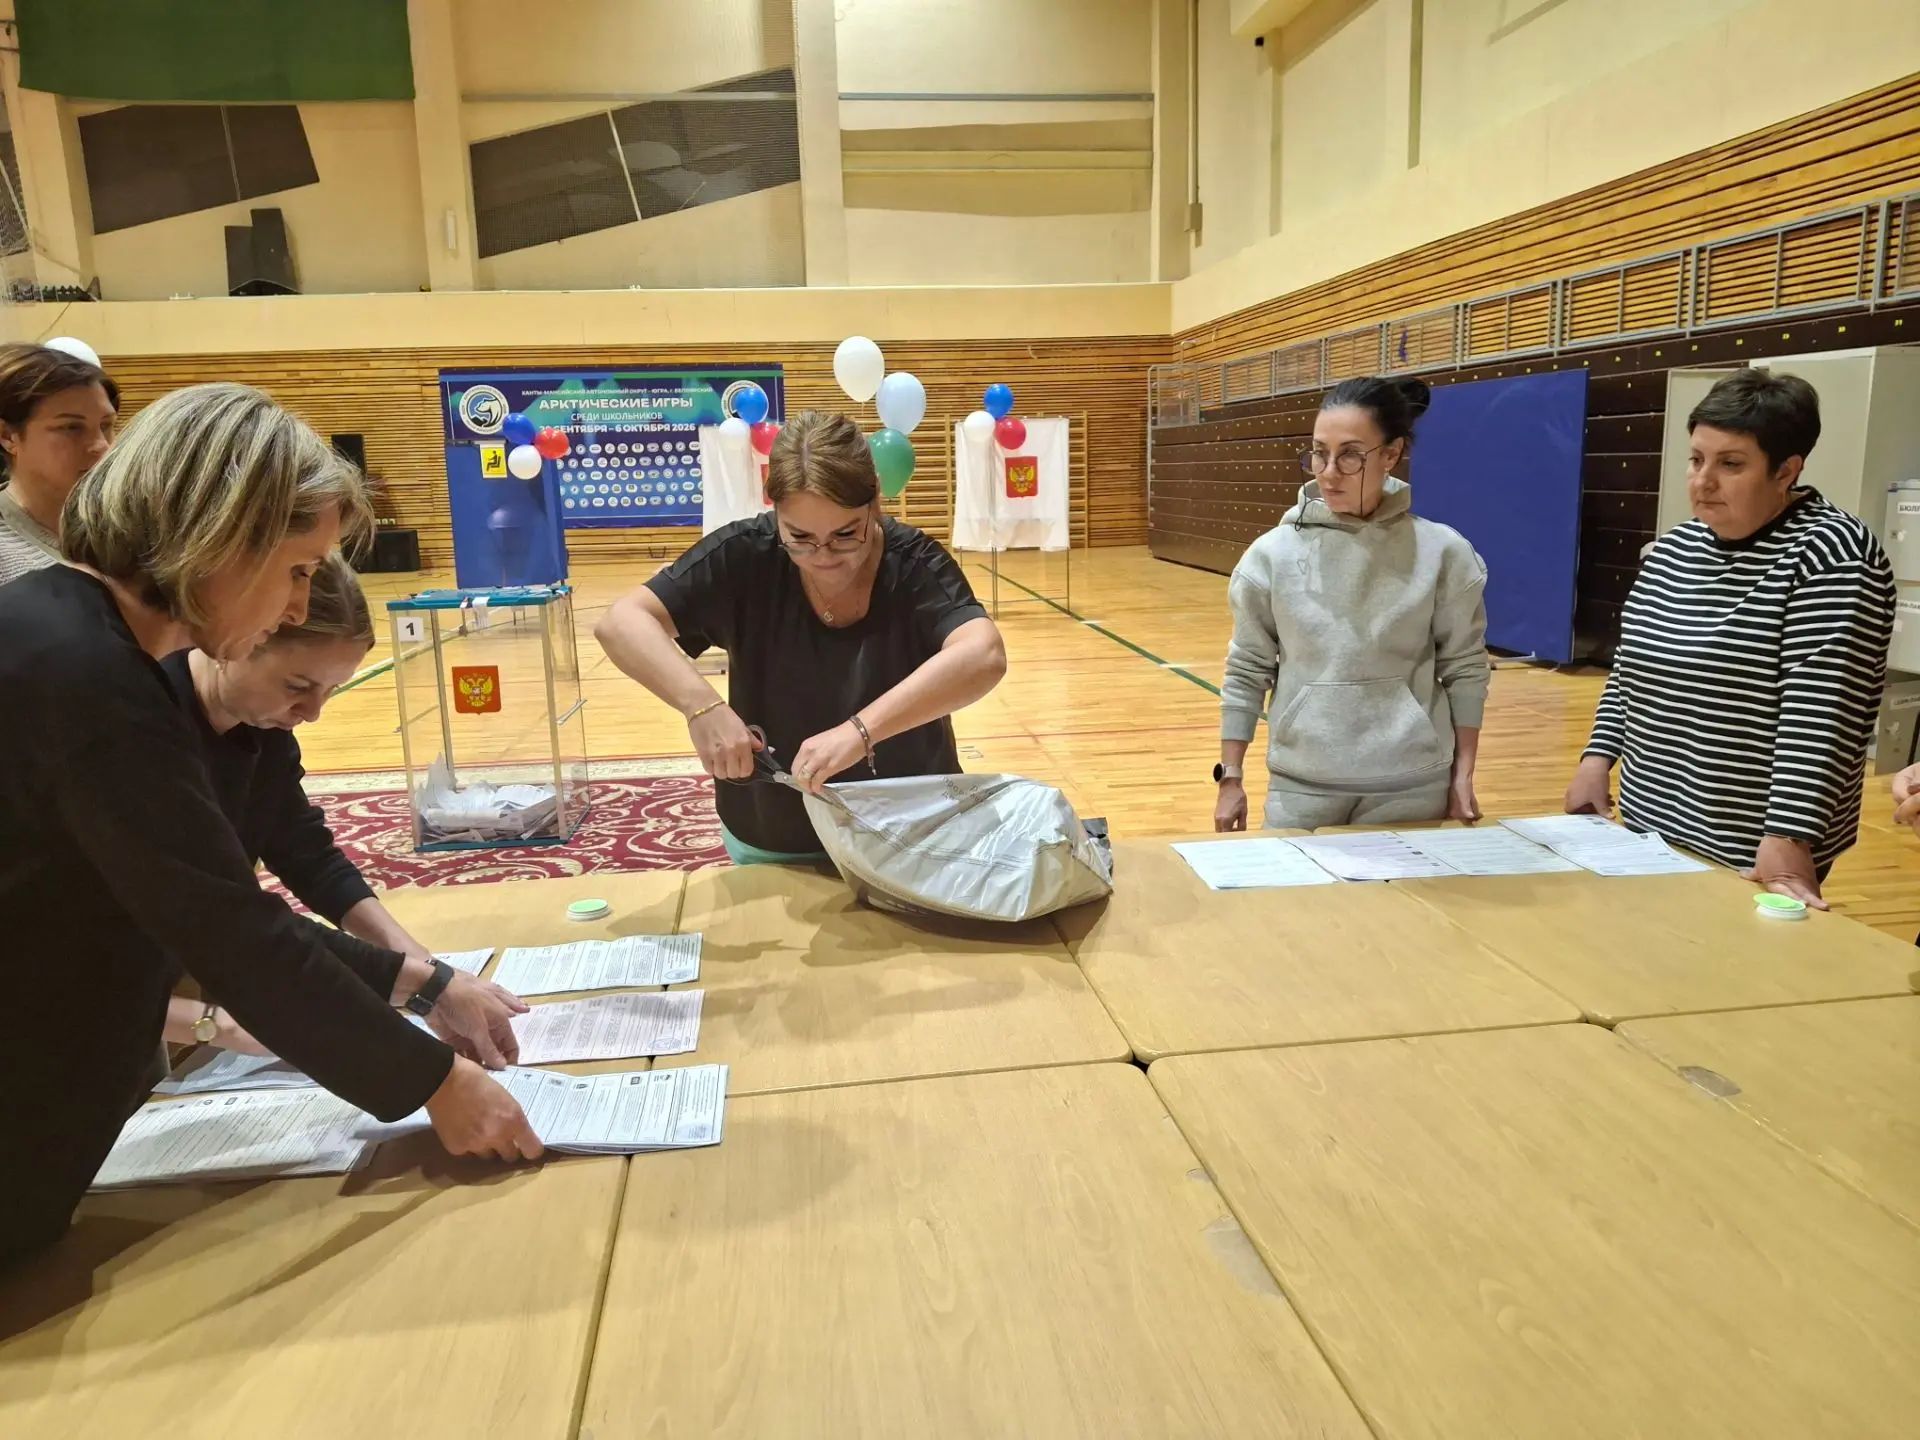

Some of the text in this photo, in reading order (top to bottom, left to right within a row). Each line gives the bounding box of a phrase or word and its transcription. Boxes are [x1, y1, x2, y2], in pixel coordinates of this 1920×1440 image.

[539, 397, 693, 409] АРКТИЧЕСКИЕ ИГРЫ
[571, 411, 663, 421] СРЕДИ ШКОЛЬНИКОВ
[615, 424, 622, 433] 6
[622, 423, 670, 432] ОКТЯБРЯ
[406, 622, 415, 636] 1
